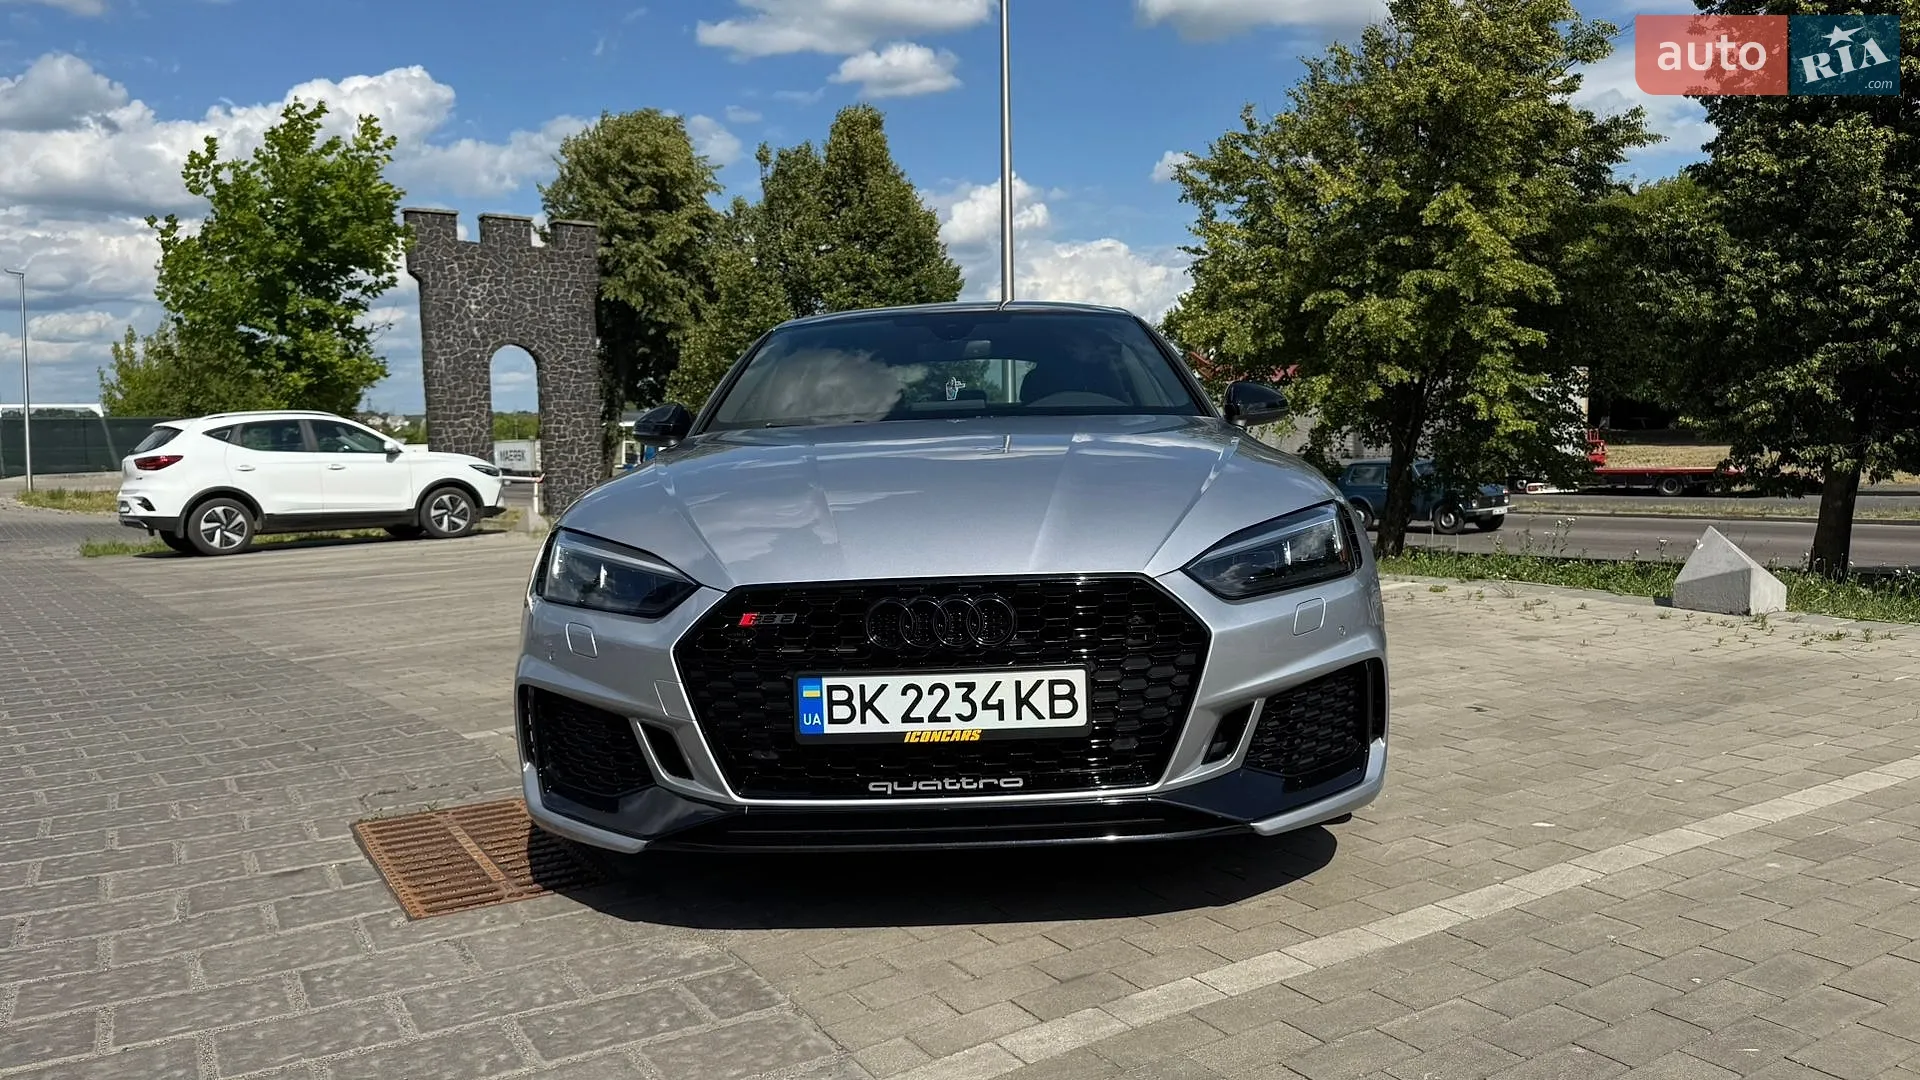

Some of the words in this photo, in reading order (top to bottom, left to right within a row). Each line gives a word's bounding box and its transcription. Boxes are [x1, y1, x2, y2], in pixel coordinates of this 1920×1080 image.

[826, 683, 890, 725] BK
[900, 680, 1005, 723] 2234
[1015, 678, 1079, 721] KB
[803, 713, 822, 726] UA
[903, 729, 983, 743] ICONCARS
[868, 776, 1024, 794] quattro
